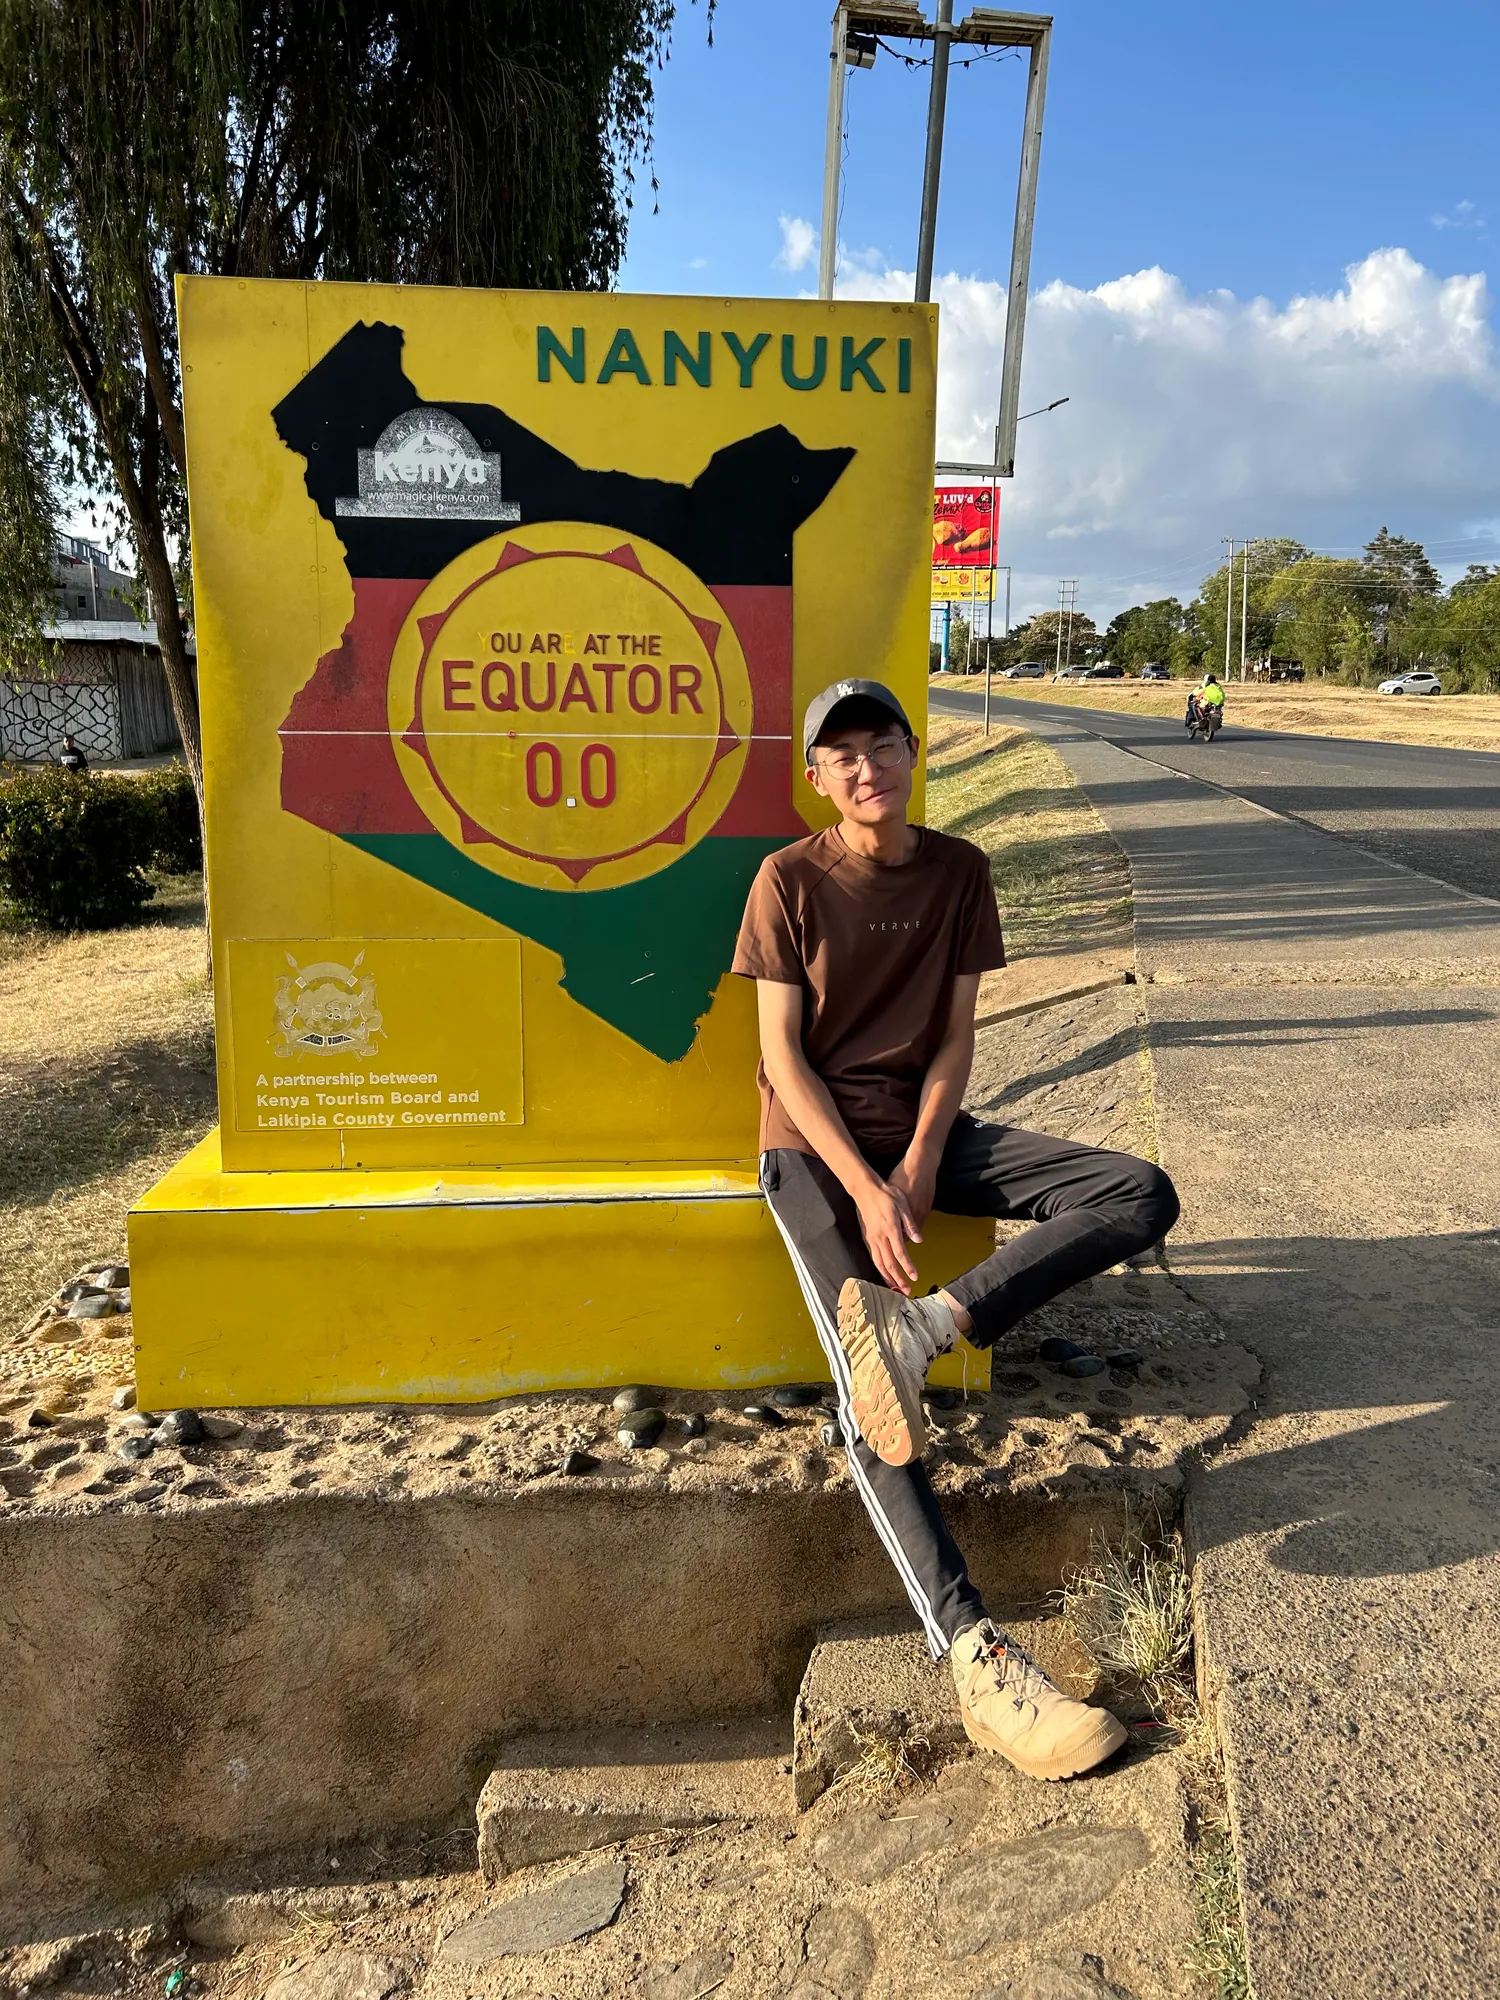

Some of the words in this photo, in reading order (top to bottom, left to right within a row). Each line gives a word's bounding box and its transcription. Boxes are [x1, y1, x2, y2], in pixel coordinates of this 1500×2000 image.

[536, 325, 912, 393] NANYUKI
[396, 419, 463, 441] MAGICAL
[374, 450, 491, 489] Kenya
[367, 491, 490, 503] www.magicalkenya.com
[943, 494, 974, 504] LUV'd
[583, 633, 611, 655] AT
[616, 635, 662, 656] THE
[442, 660, 704, 715] EQUATOR
[836, 683, 854, 698] LA
[869, 920, 920, 931] VERVE
[256, 1074, 269, 1087] A
[273, 1072, 365, 1089] partnership
[369, 1071, 438, 1085] between
[257, 1094, 310, 1109] Kenya
[315, 1092, 385, 1106] Tourism
[391, 1090, 442, 1105] Board
[448, 1089, 480, 1103] and
[258, 1113, 327, 1128] Laikipia
[333, 1112, 395, 1127] County
[401, 1109, 506, 1124] Government
